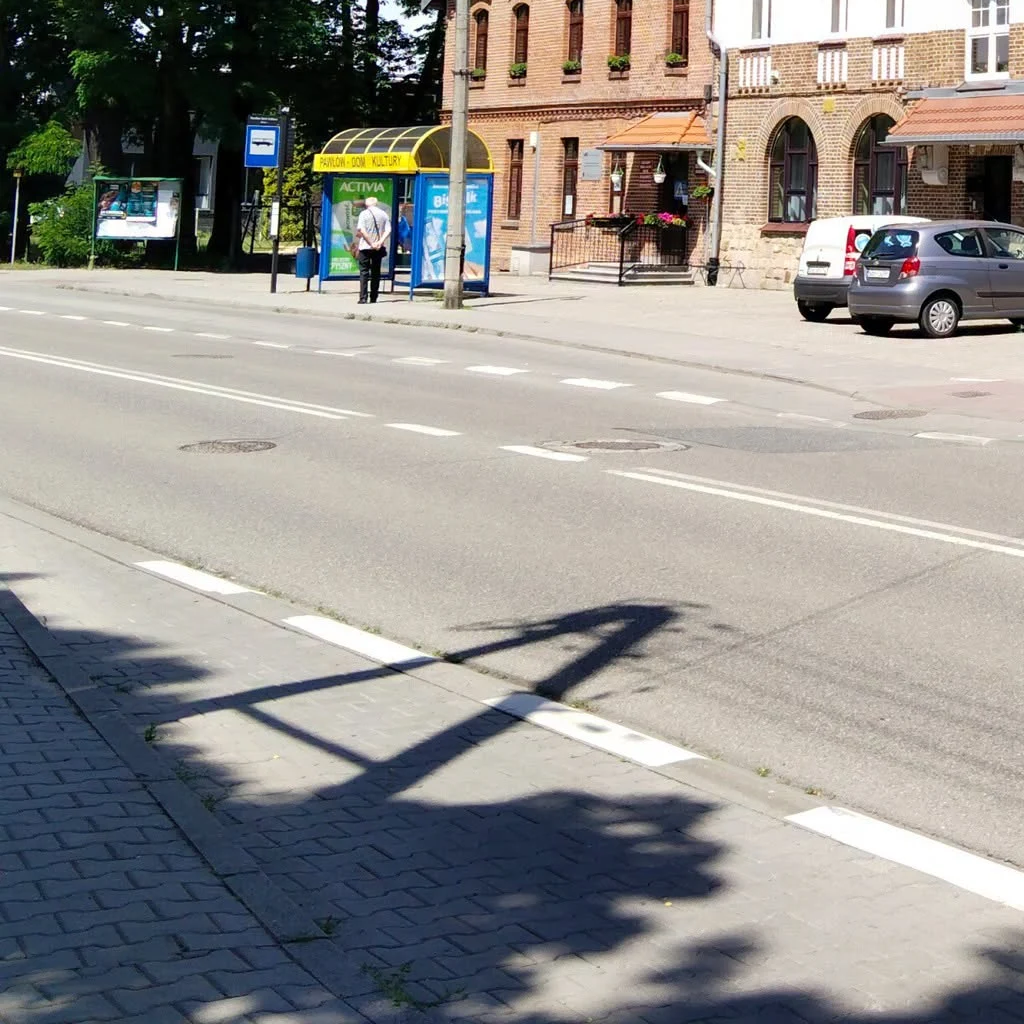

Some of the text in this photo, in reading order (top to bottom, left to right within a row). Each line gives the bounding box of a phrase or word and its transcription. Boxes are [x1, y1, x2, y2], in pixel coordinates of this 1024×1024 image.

[351, 156, 366, 168] DOM
[372, 155, 402, 167] KULTURY
[339, 181, 385, 192] ACTIVIA
